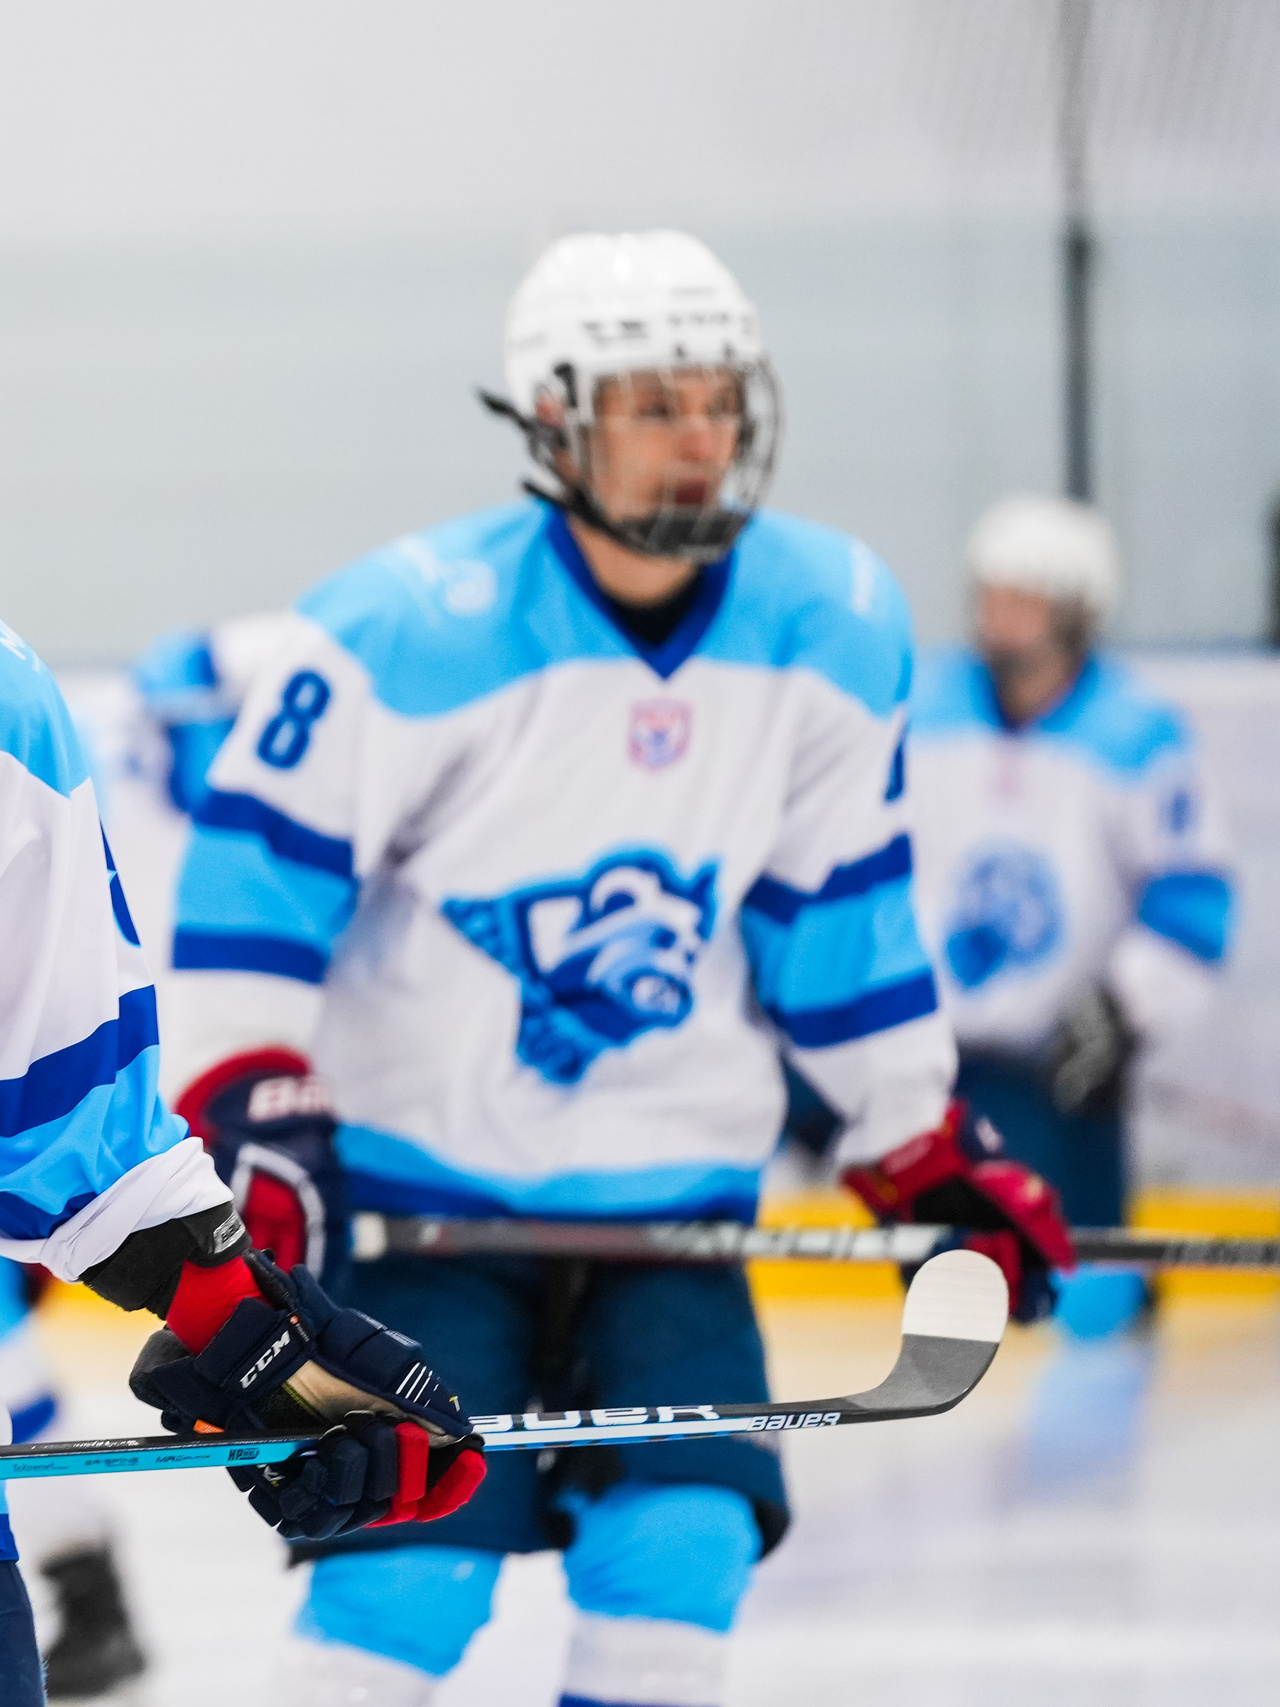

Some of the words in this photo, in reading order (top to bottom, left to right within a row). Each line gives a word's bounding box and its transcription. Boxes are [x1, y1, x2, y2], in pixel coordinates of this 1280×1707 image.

[255, 669, 332, 770] 8
[239, 1330, 291, 1389] CCM
[467, 1404, 720, 1433] AUER
[746, 1412, 841, 1431] BAUER
